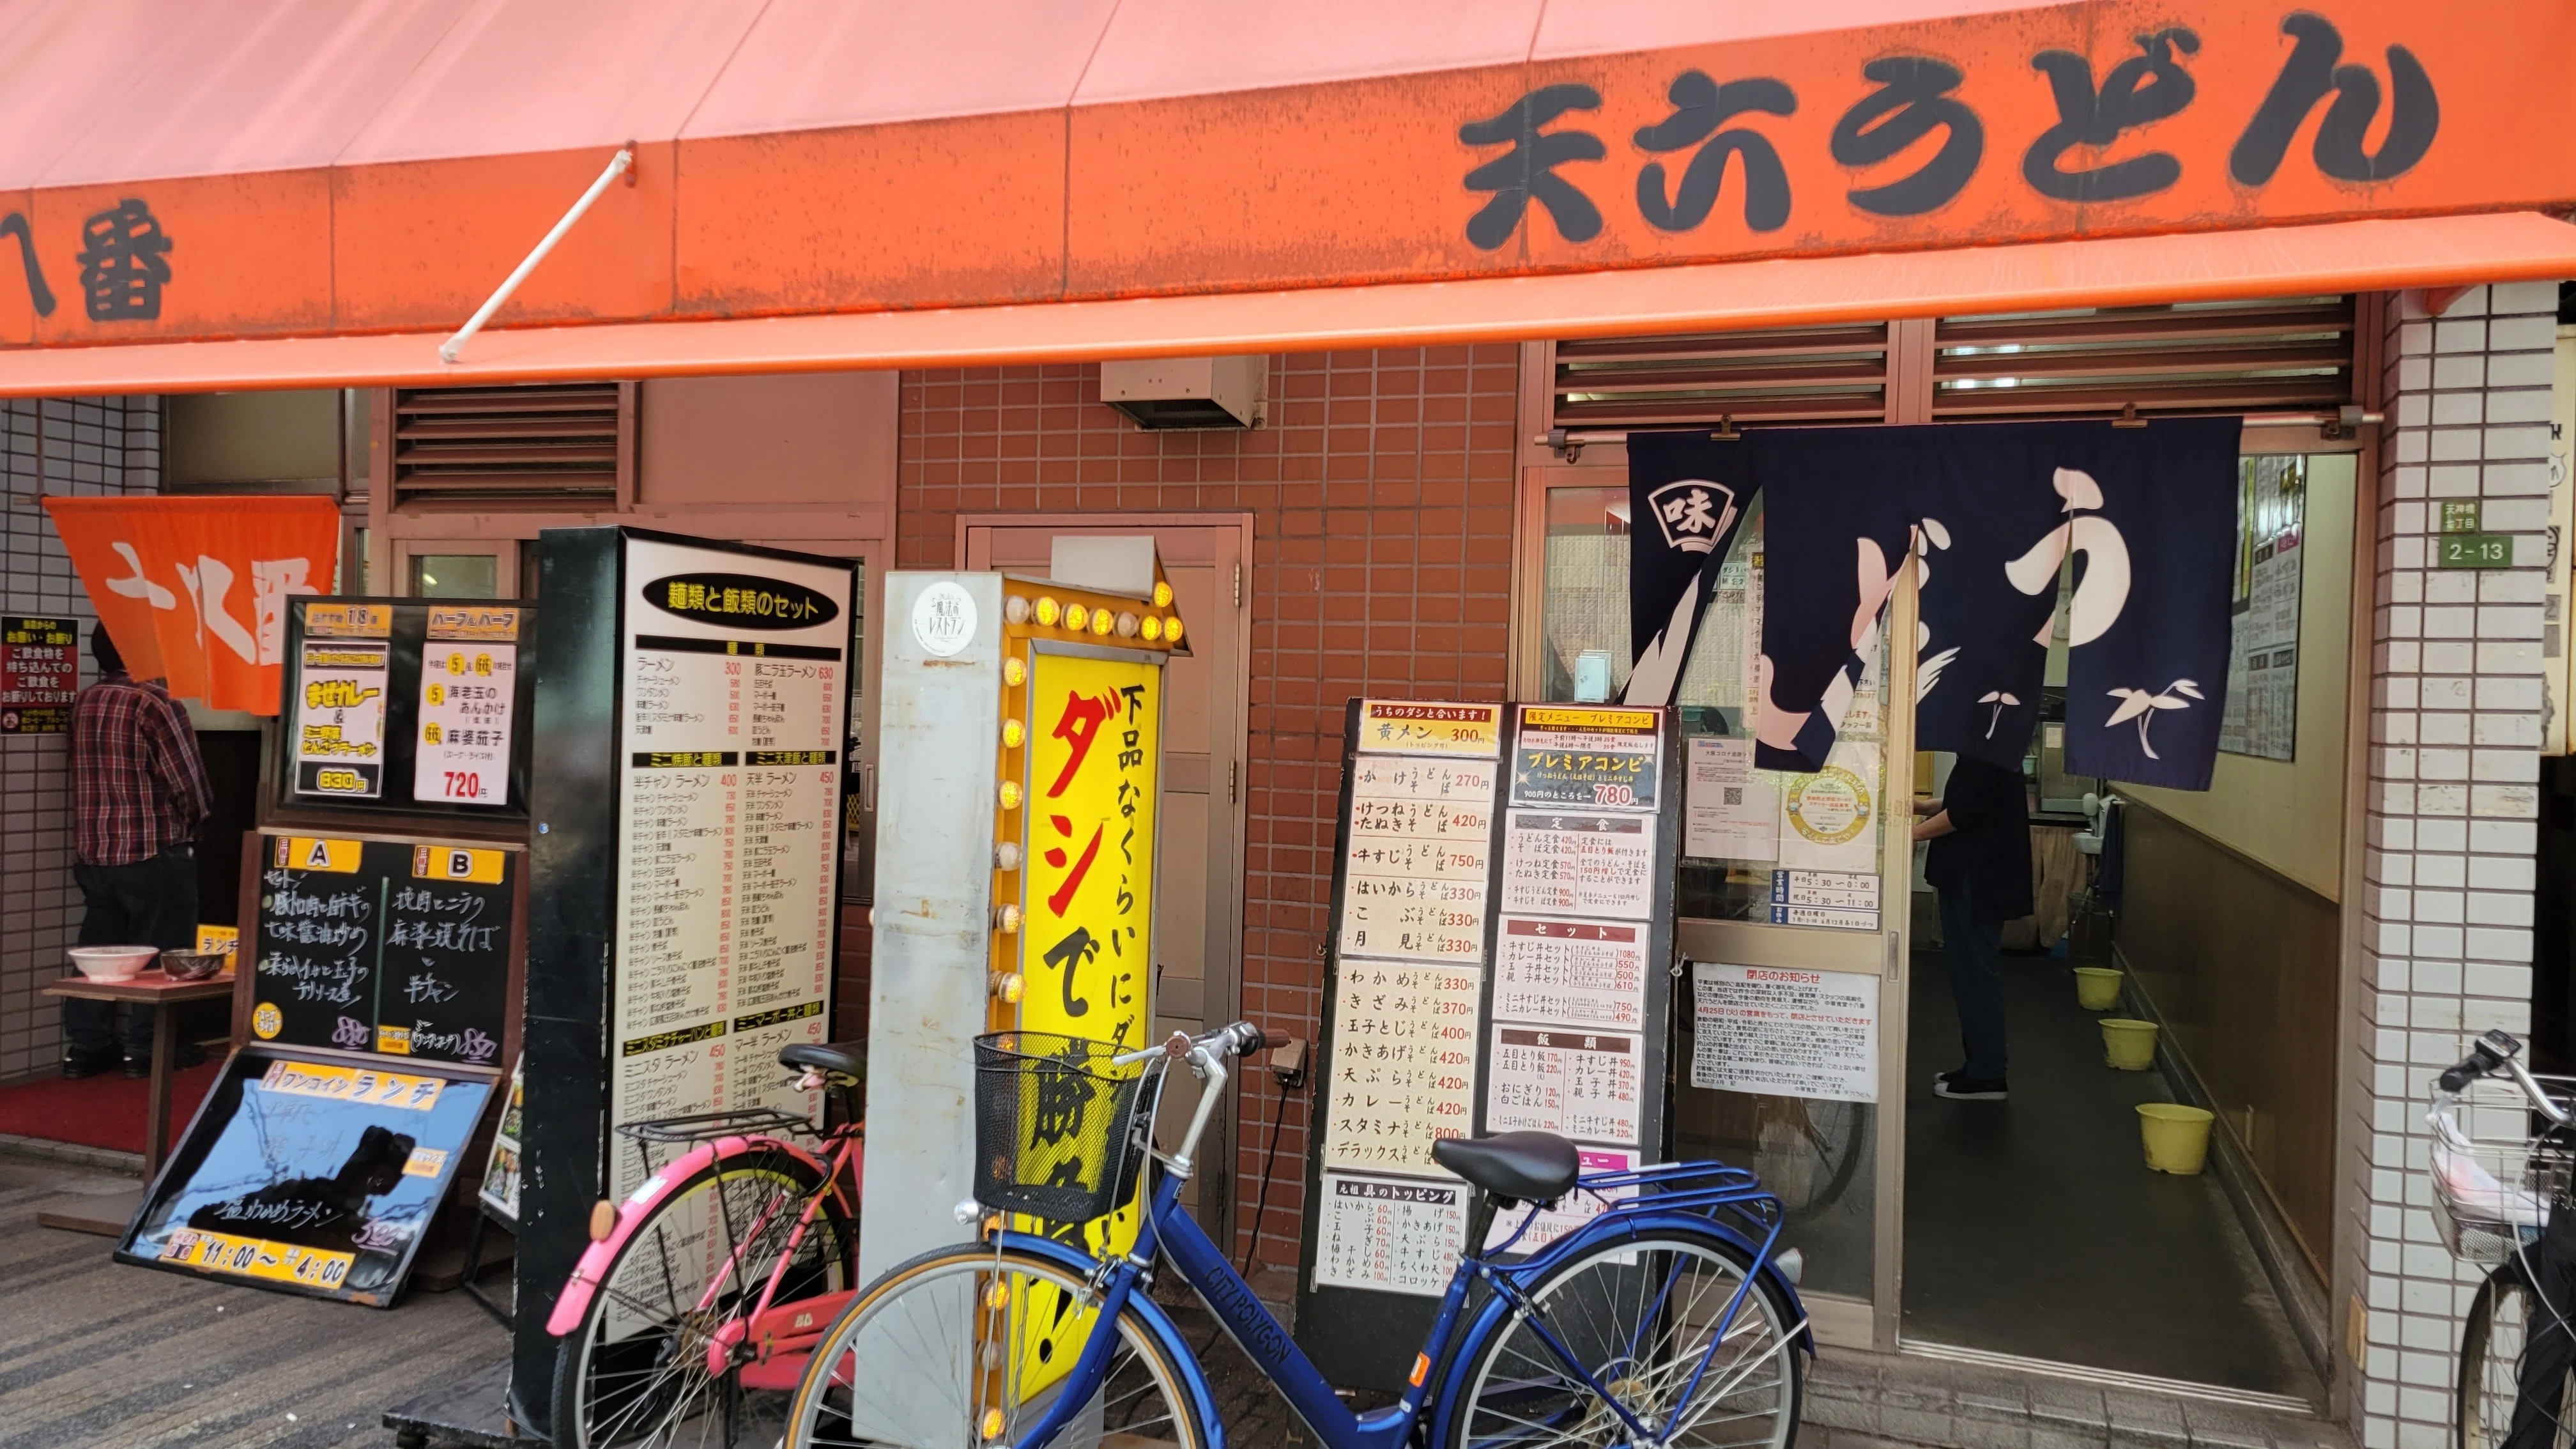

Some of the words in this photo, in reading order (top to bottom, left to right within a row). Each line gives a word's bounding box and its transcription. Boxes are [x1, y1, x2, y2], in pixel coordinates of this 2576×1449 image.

[1459, 12, 2439, 249] 天六うどん
[1662, 488, 1719, 535] 味
[2445, 518, 2474, 529] 七丁目
[2448, 542, 2504, 560] 2-13
[346, 608, 370, 627] 18
[930, 617, 965, 636] レストラン
[12, 647, 64, 660] ご飲食物を
[6, 661, 73, 673] 持ち込んでの
[636, 657, 675, 671] ラーメン
[725, 662, 742, 675] 300
[819, 666, 834, 680] 630
[17, 676, 60, 688] ご飲食を
[3, 690, 77, 703] お断りしております
[1374, 705, 1487, 721] うちのダシと合います!
[1528, 711, 1581, 723] 限定メニュー
[1589, 714, 1651, 726] プレミアコンビ
[447, 730, 505, 746] 麻婆茄子
[1377, 722, 1433, 741] 黄メン
[1450, 728, 1485, 744] 300円
[1528, 751, 1645, 773] プレミアコンビ
[675, 772, 711, 788] ラーメン
[720, 774, 738, 787] 400
[767, 771, 797, 785] ラーメン
[820, 770, 834, 784] 450
[1455, 774, 1489, 790] 270円
[1593, 784, 1639, 806] 780円
[1360, 801, 1405, 816] けつね
[1452, 815, 1487, 830] 420円
[1551, 816, 1610, 832] 定食
[1359, 818, 1402, 832] たぬき
[1518, 833, 1560, 845] うどん定食
[307, 839, 332, 868] A
[1357, 849, 1400, 864] 牛すじ
[1450, 854, 1484, 870] 750円
[448, 850, 473, 877] B
[1515, 858, 1560, 870] けつね定食
[1356, 880, 1416, 898] はいから
[1448, 887, 1482, 901] 330円
[1447, 913, 1480, 927] 330円
[1535, 923, 1608, 940] セット
[1445, 939, 1478, 953] 330円
[1349, 969, 1410, 986] わかめ
[1443, 977, 1475, 991] 330円
[1746, 969, 1821, 984] 閉店のお知らせ
[1349, 992, 1409, 1011] きざみ
[1442, 1001, 1473, 1016] 370円
[807, 1022, 822, 1036] 450
[1347, 1018, 1406, 1036] 玉子とじ
[1440, 1026, 1471, 1040] 400円
[709, 1043, 726, 1058] 450
[1344, 1041, 1407, 1061] かきあげ
[1439, 1052, 1470, 1066] 420円
[1575, 1055, 1618, 1068] 牛すじ丼
[1342, 1066, 1402, 1086] 天ぷら
[1437, 1076, 1469, 1091] 420円
[1575, 1066, 1618, 1078] カレー丼
[282, 1072, 349, 1094] ワンコイン
[351, 1075, 439, 1107] ランチ
[1501, 1083, 1542, 1095] おにぎり
[1341, 1092, 1402, 1108] カレー
[1436, 1101, 1468, 1116] 420円
[1501, 1095, 1542, 1107] 白ごはん
[1339, 1117, 1401, 1137] スタミナ
[1337, 1141, 1400, 1163] デラックス
[1363, 1183, 1455, 1204] 具のトッピング
[202, 1238, 257, 1270] 11:00
[293, 1254, 347, 1284] 4:00
[1397, 1274, 1439, 1289] コロッケ
[1205, 1267, 1238, 1301] CITY
[1233, 1295, 1292, 1365] POLYGON
